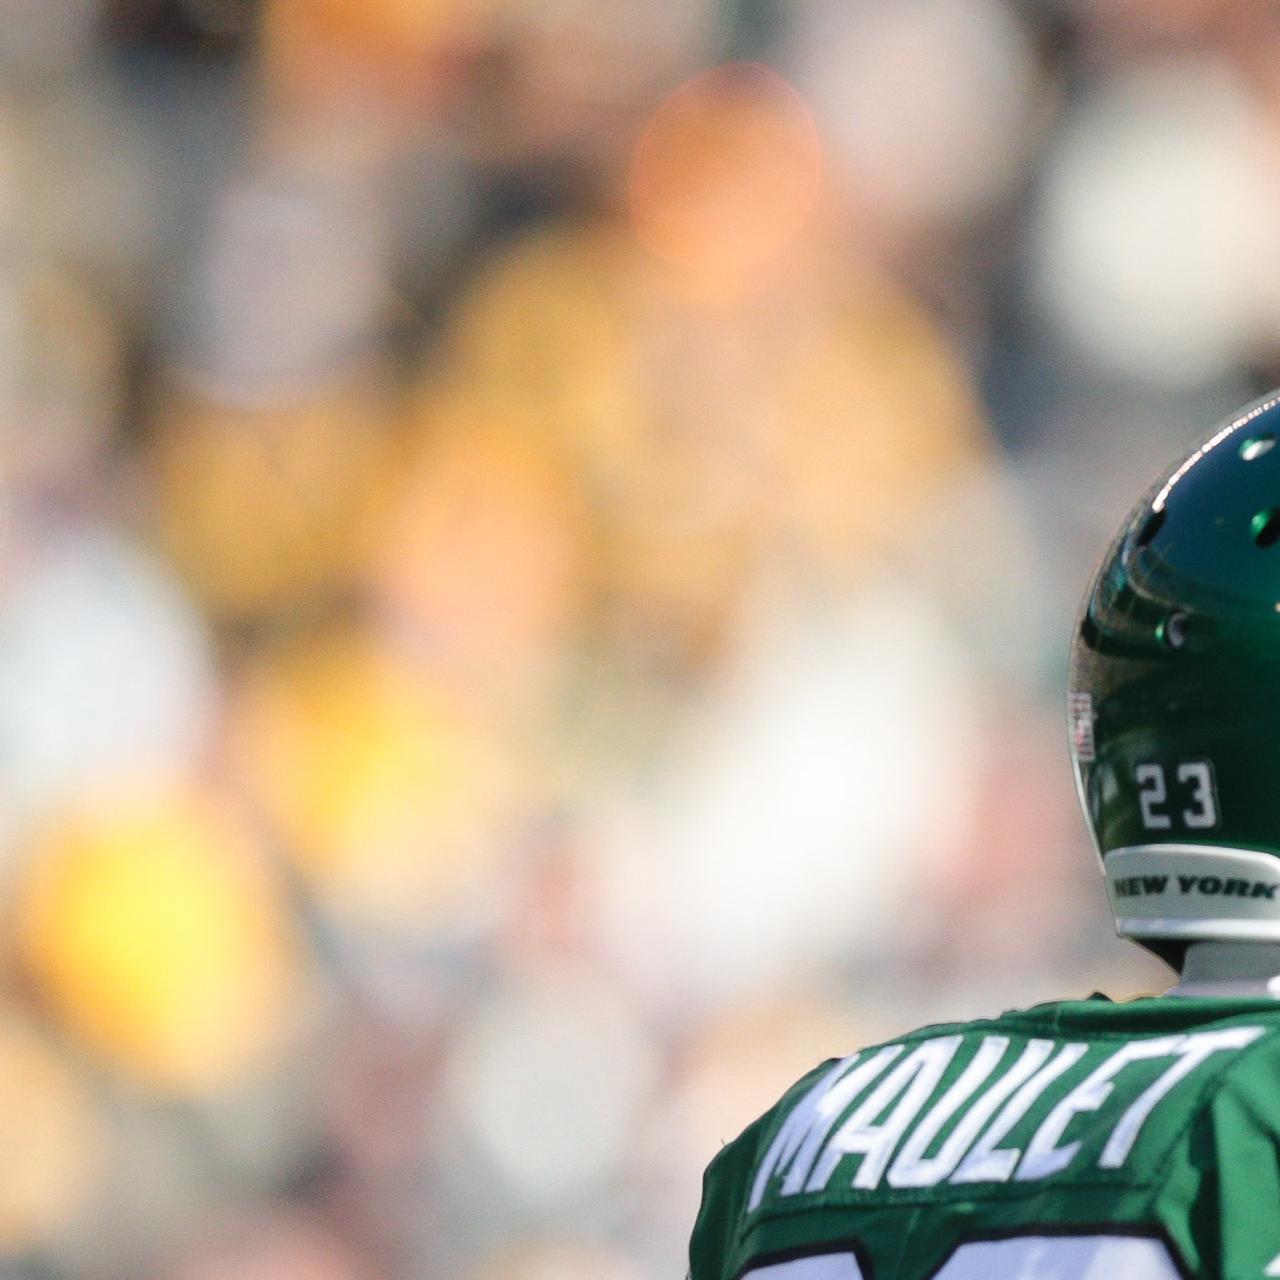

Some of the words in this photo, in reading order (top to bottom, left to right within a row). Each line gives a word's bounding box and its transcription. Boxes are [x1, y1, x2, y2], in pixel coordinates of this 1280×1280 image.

[1135, 761, 1217, 830] 23
[1114, 874, 1168, 898] NEW
[1176, 872, 1280, 900] YORK
[746, 1025, 1268, 1214] MAULET
